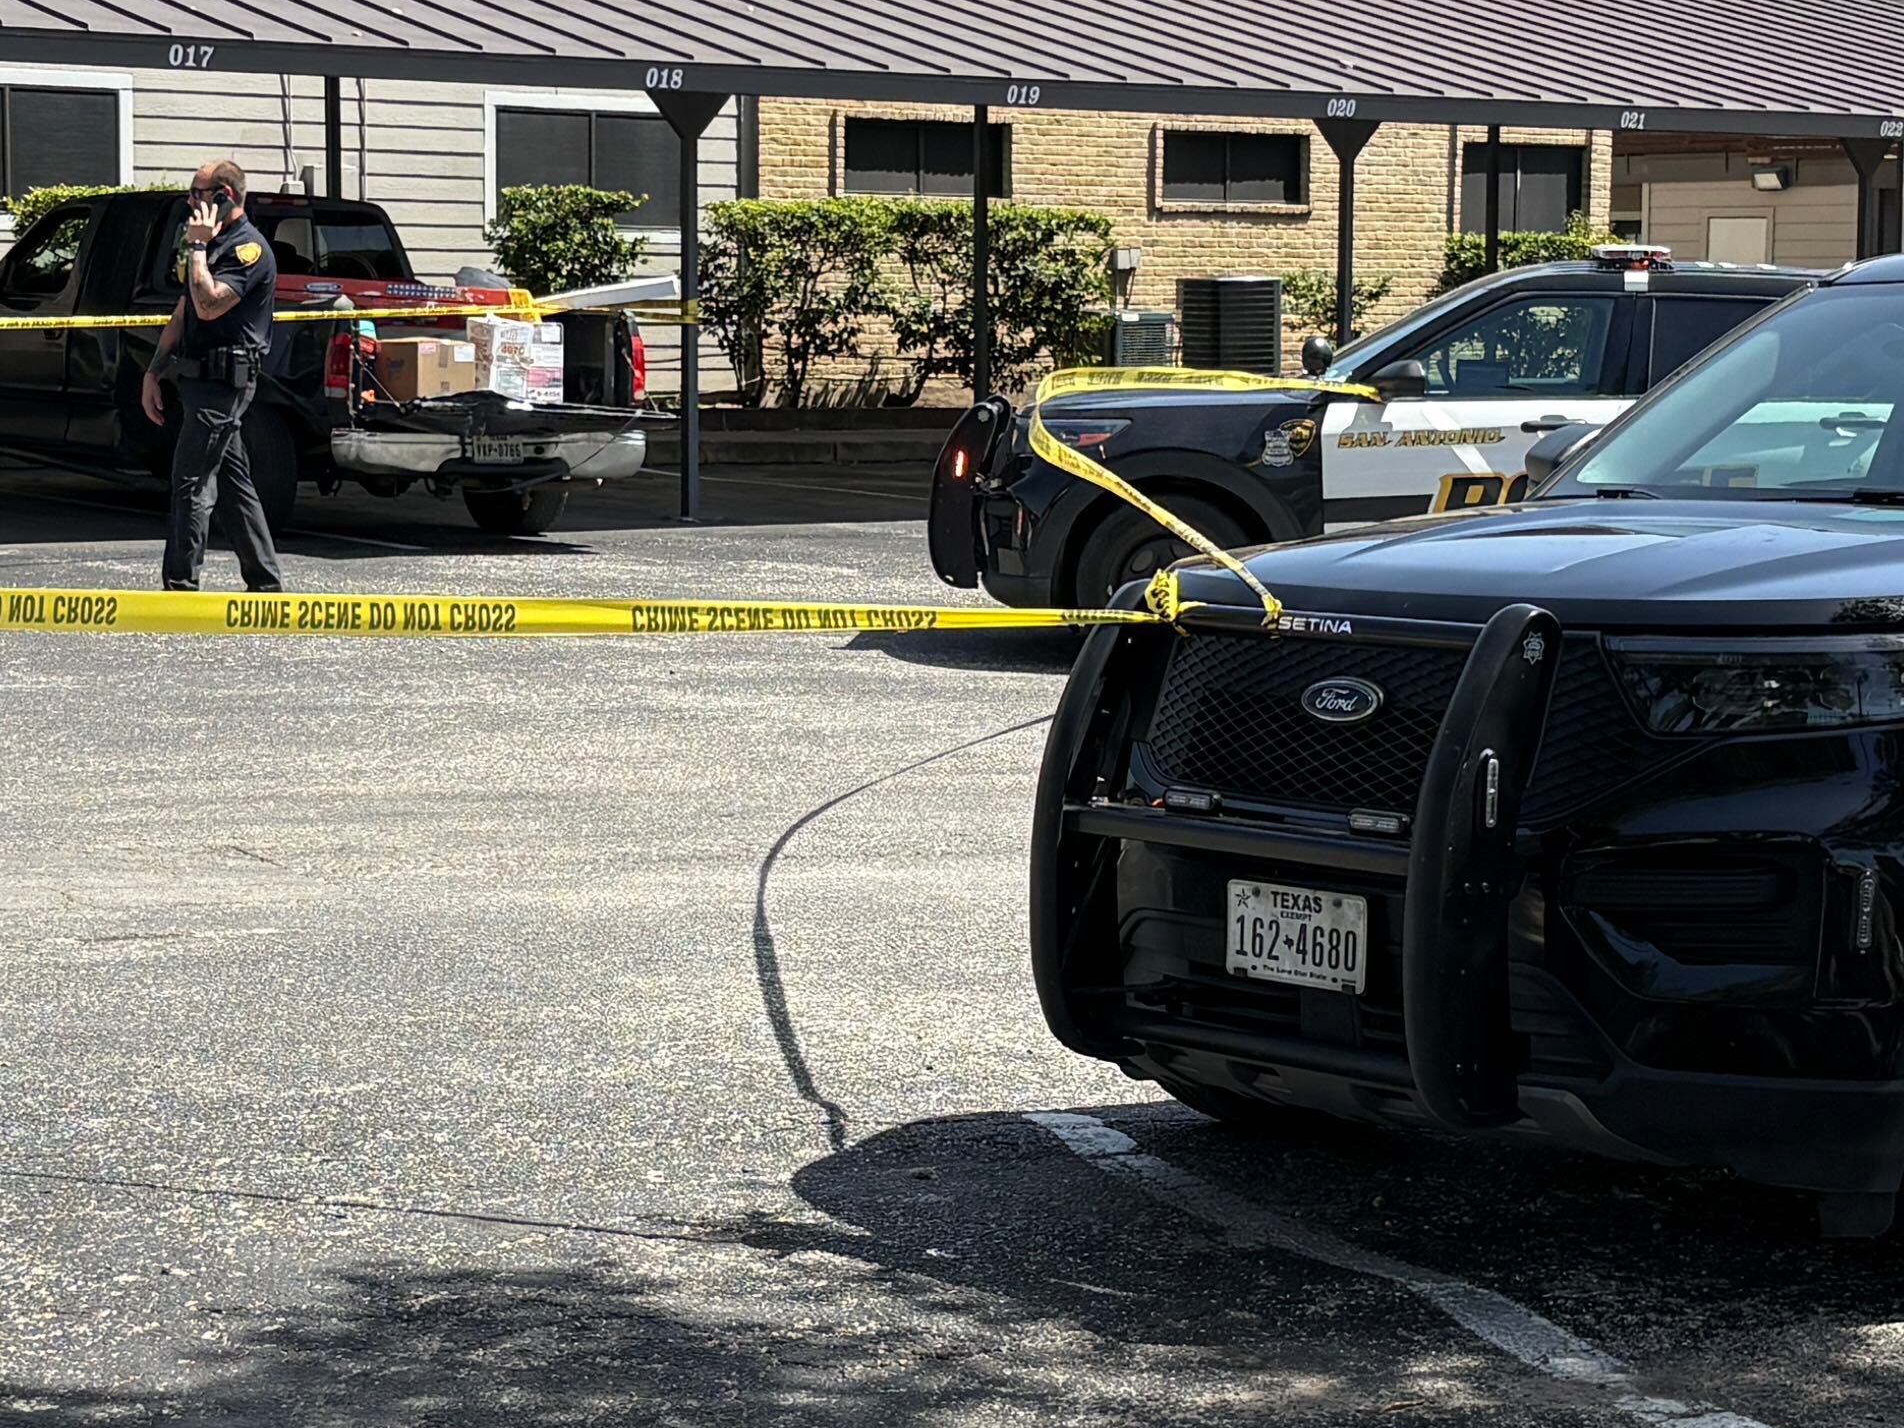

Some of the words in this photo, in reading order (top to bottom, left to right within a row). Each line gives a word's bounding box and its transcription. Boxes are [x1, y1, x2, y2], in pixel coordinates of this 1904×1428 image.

[168, 44, 214, 68] 017
[645, 67, 683, 89] 018
[1007, 84, 1040, 105] 019
[1326, 98, 1356, 118] 020
[1621, 111, 1645, 130] 021
[1337, 431, 1393, 449] SAN
[1394, 427, 1506, 447] ANTONIO
[1278, 616, 1352, 635] SETINA
[1315, 687, 1358, 712] Ford
[1271, 890, 1323, 914] TEXAS
